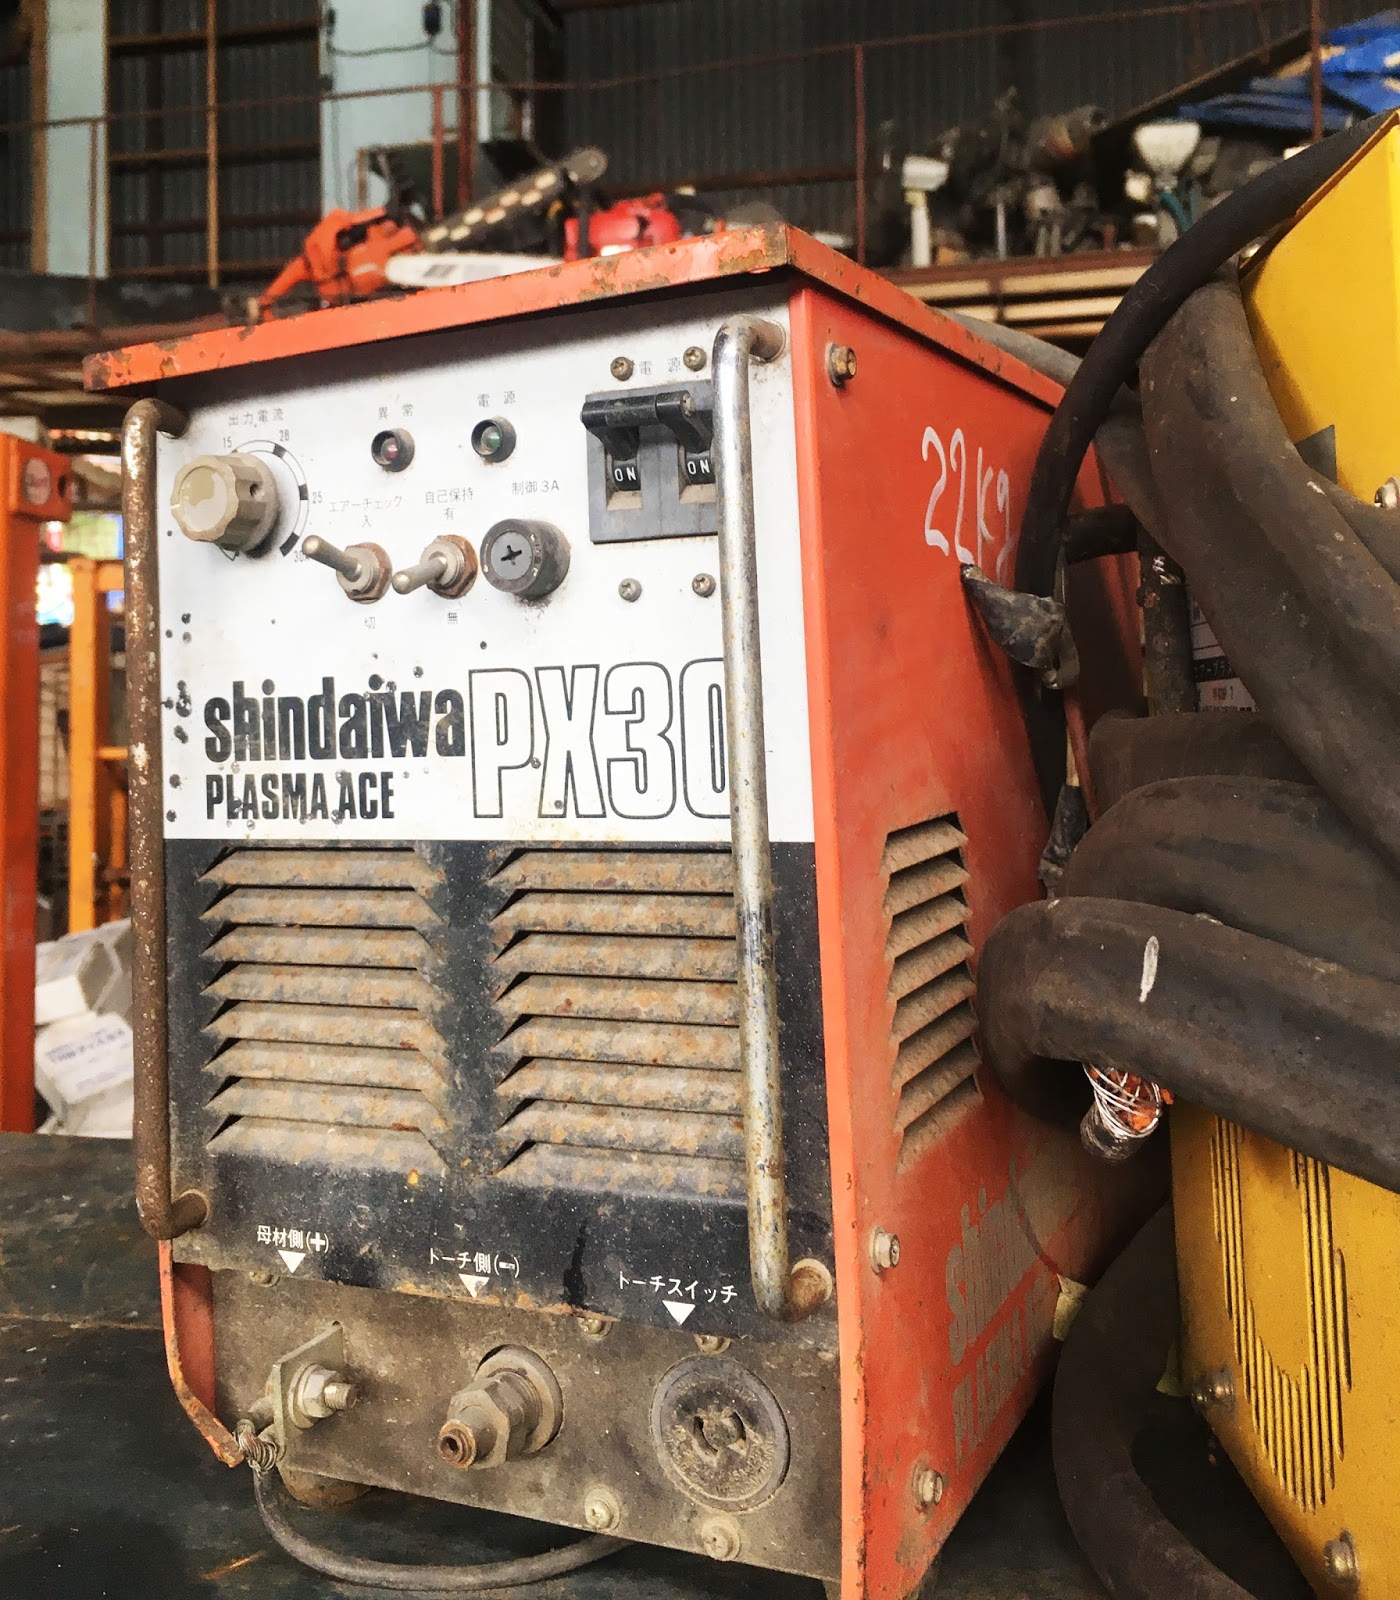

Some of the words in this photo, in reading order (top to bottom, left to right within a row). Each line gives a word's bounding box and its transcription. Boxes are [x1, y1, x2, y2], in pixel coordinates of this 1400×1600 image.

[614, 466, 637, 482] ON
[684, 459, 711, 476] ON
[312, 491, 323, 504] 25
[203, 674, 467, 763] shindaiwa
[468, 656, 732, 821] PX30
[205, 772, 329, 820] PLASMA
[335, 770, 395, 820] ACE
[619, 1270, 738, 1304] トーチスイッチ
